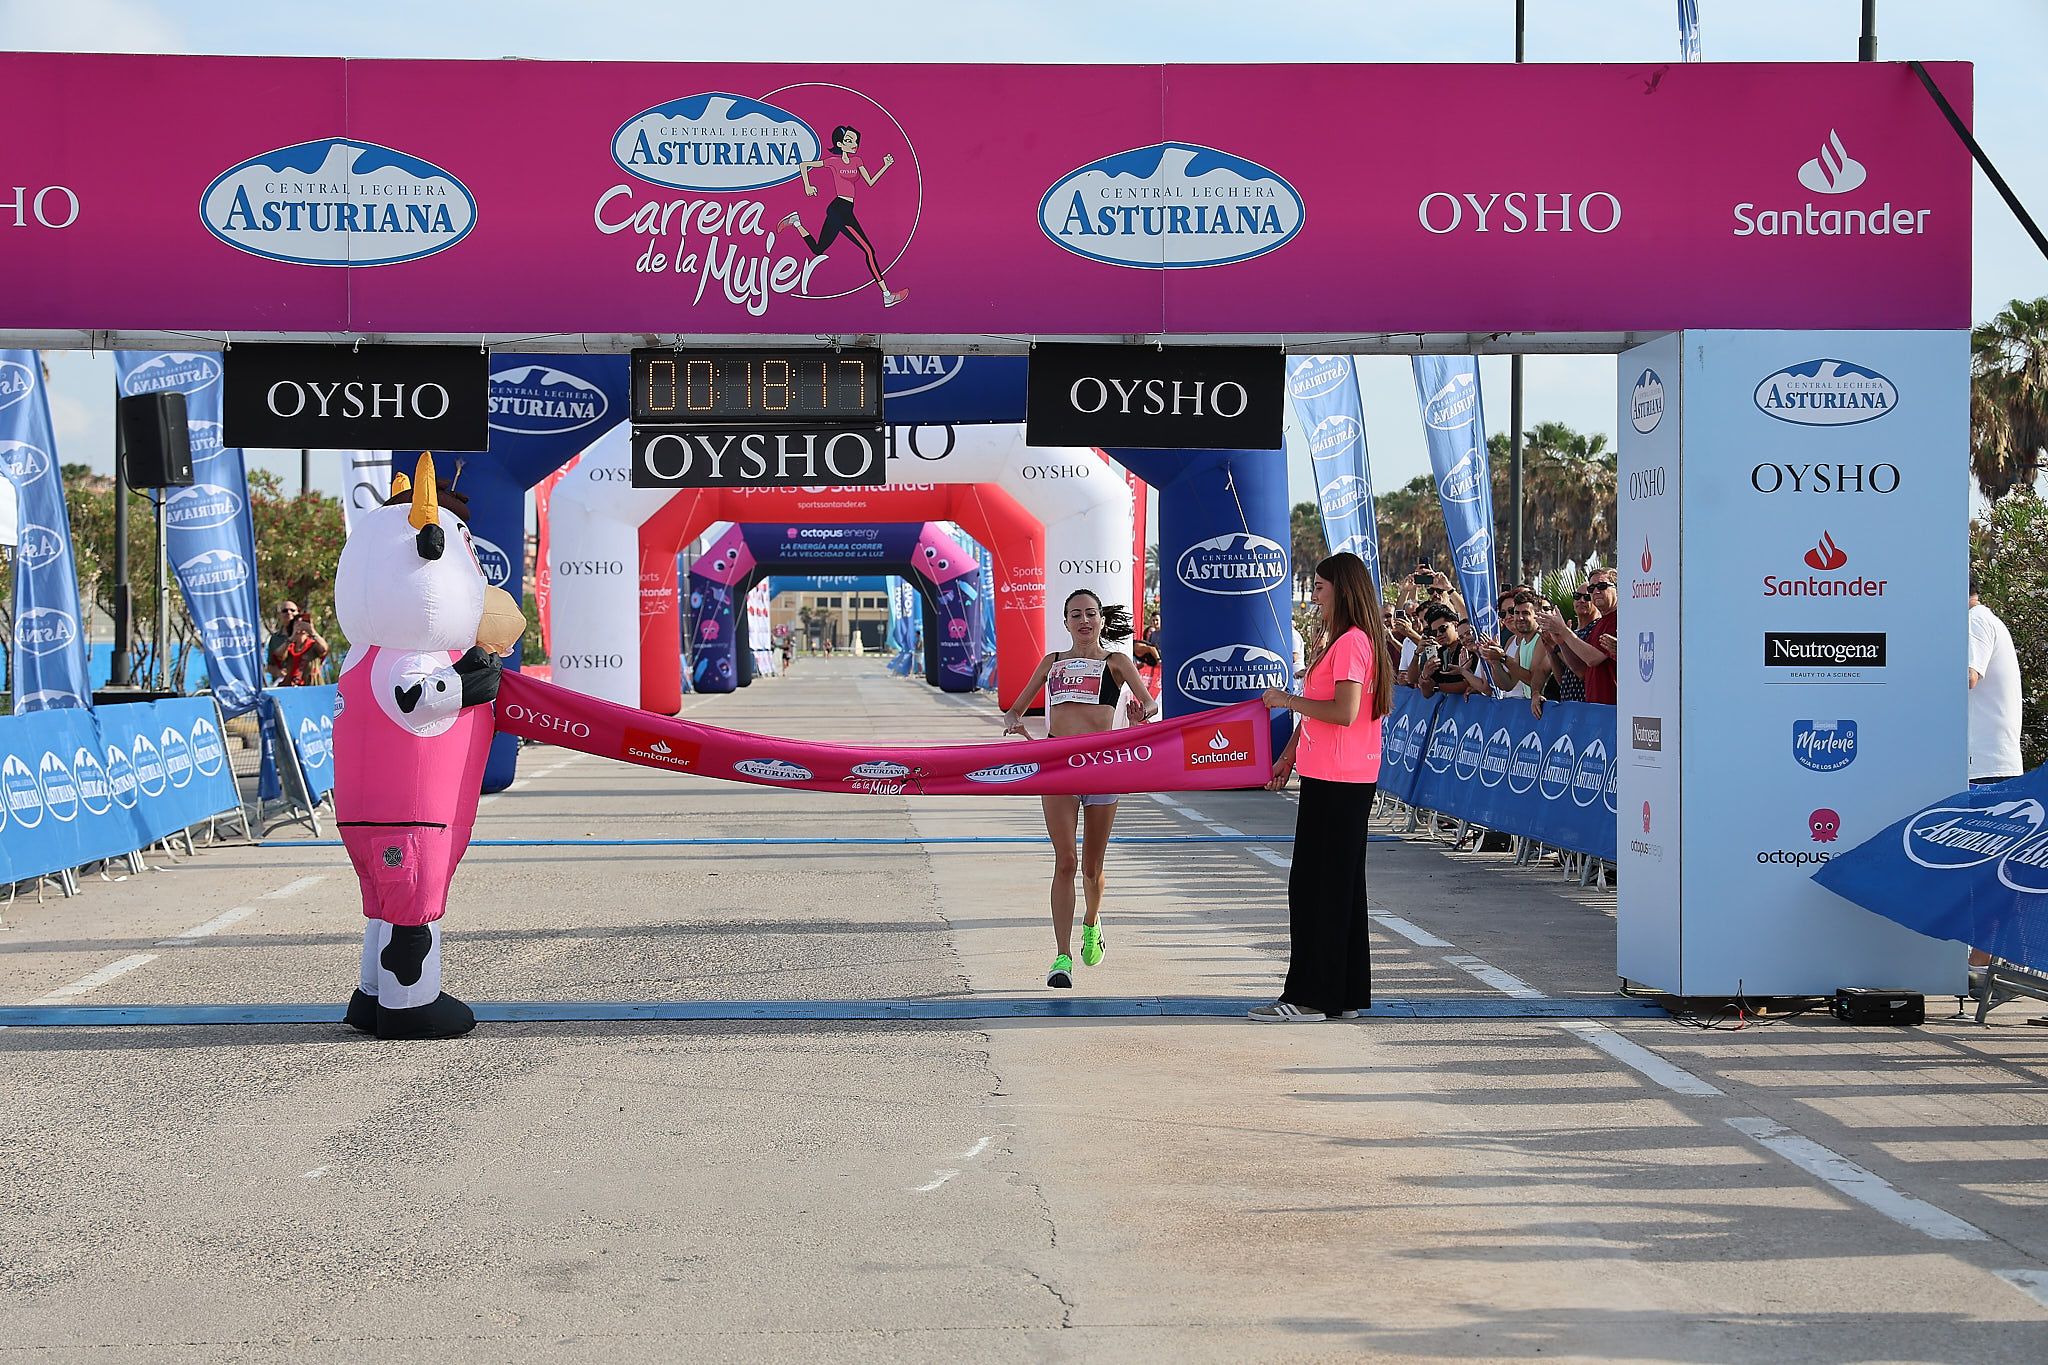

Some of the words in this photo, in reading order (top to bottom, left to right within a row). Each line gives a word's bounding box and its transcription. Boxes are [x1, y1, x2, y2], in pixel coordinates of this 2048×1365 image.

[660, 127, 725, 137] CENTRAL
[731, 127, 798, 137] LECHERA
[628, 128, 803, 166] ASTURIANA
[265, 182, 351, 195] CENTRAL
[359, 184, 447, 196] LECHERA
[1100, 186, 1183, 199] CENTRAL
[1192, 186, 1276, 198] LECHERA
[0, 185, 80, 229] HO
[222, 184, 456, 233] ASTURIANA
[594, 184, 765, 236] Carrera
[1059, 189, 1285, 236] ASTURIANA
[1417, 191, 1622, 234] OYSHO
[1733, 201, 1931, 237] Santander
[635, 237, 667, 274] de
[675, 237, 698, 274] la
[692, 231, 830, 316] Mujer
[884, 355, 946, 375] ANA
[490, 388, 540, 397] CENTRAL
[544, 389, 594, 399] LECHERA
[649, 360, 864, 411] 00:18:17
[1787, 381, 1833, 389] CENTRAL
[1837, 381, 1884, 389] LECHERA
[267, 380, 450, 420] OYSHO
[1070, 377, 1248, 418] OYSHO
[1764, 383, 1889, 410] ASTURIANA
[488, 397, 596, 418] STURIANA
[644, 433, 873, 480] OYSHO
[1022, 465, 1090, 480] OYSHO
[1751, 462, 1901, 494] OYSHO
[1630, 466, 1665, 501] OYSHO
[798, 501, 867, 509] sportssantander.es
[800, 528, 843, 540] octopus
[843, 528, 880, 540] energy
[780, 543, 791, 551] LA
[828, 543, 850, 551] PARA
[850, 543, 883, 551] CORRER
[559, 560, 623, 576] OYSHO
[1012, 566, 1043, 578] Sports
[1058, 559, 1122, 575] OYSHO
[1184, 556, 1283, 579] ASTURIANA
[639, 573, 660, 582] orts
[1763, 575, 1888, 597] Santander
[639, 587, 673, 597] ntander
[1632, 579, 1662, 599] Santander
[1772, 639, 1879, 663] Neutrogena
[559, 654, 623, 669] OYSHO
[1247, 663, 1282, 671] LECHERA
[1062, 676, 1084, 685] 016
[1184, 667, 1283, 690] ASTURIANA
[505, 704, 590, 738] OYSHO
[1796, 731, 1854, 759] Marlene
[628, 747, 690, 766] Santander
[1068, 745, 1153, 769] OYSHO
[1191, 749, 1249, 765] Santander
[1832, 757, 1850, 769] ALPES
[1757, 849, 1831, 867] octopus
